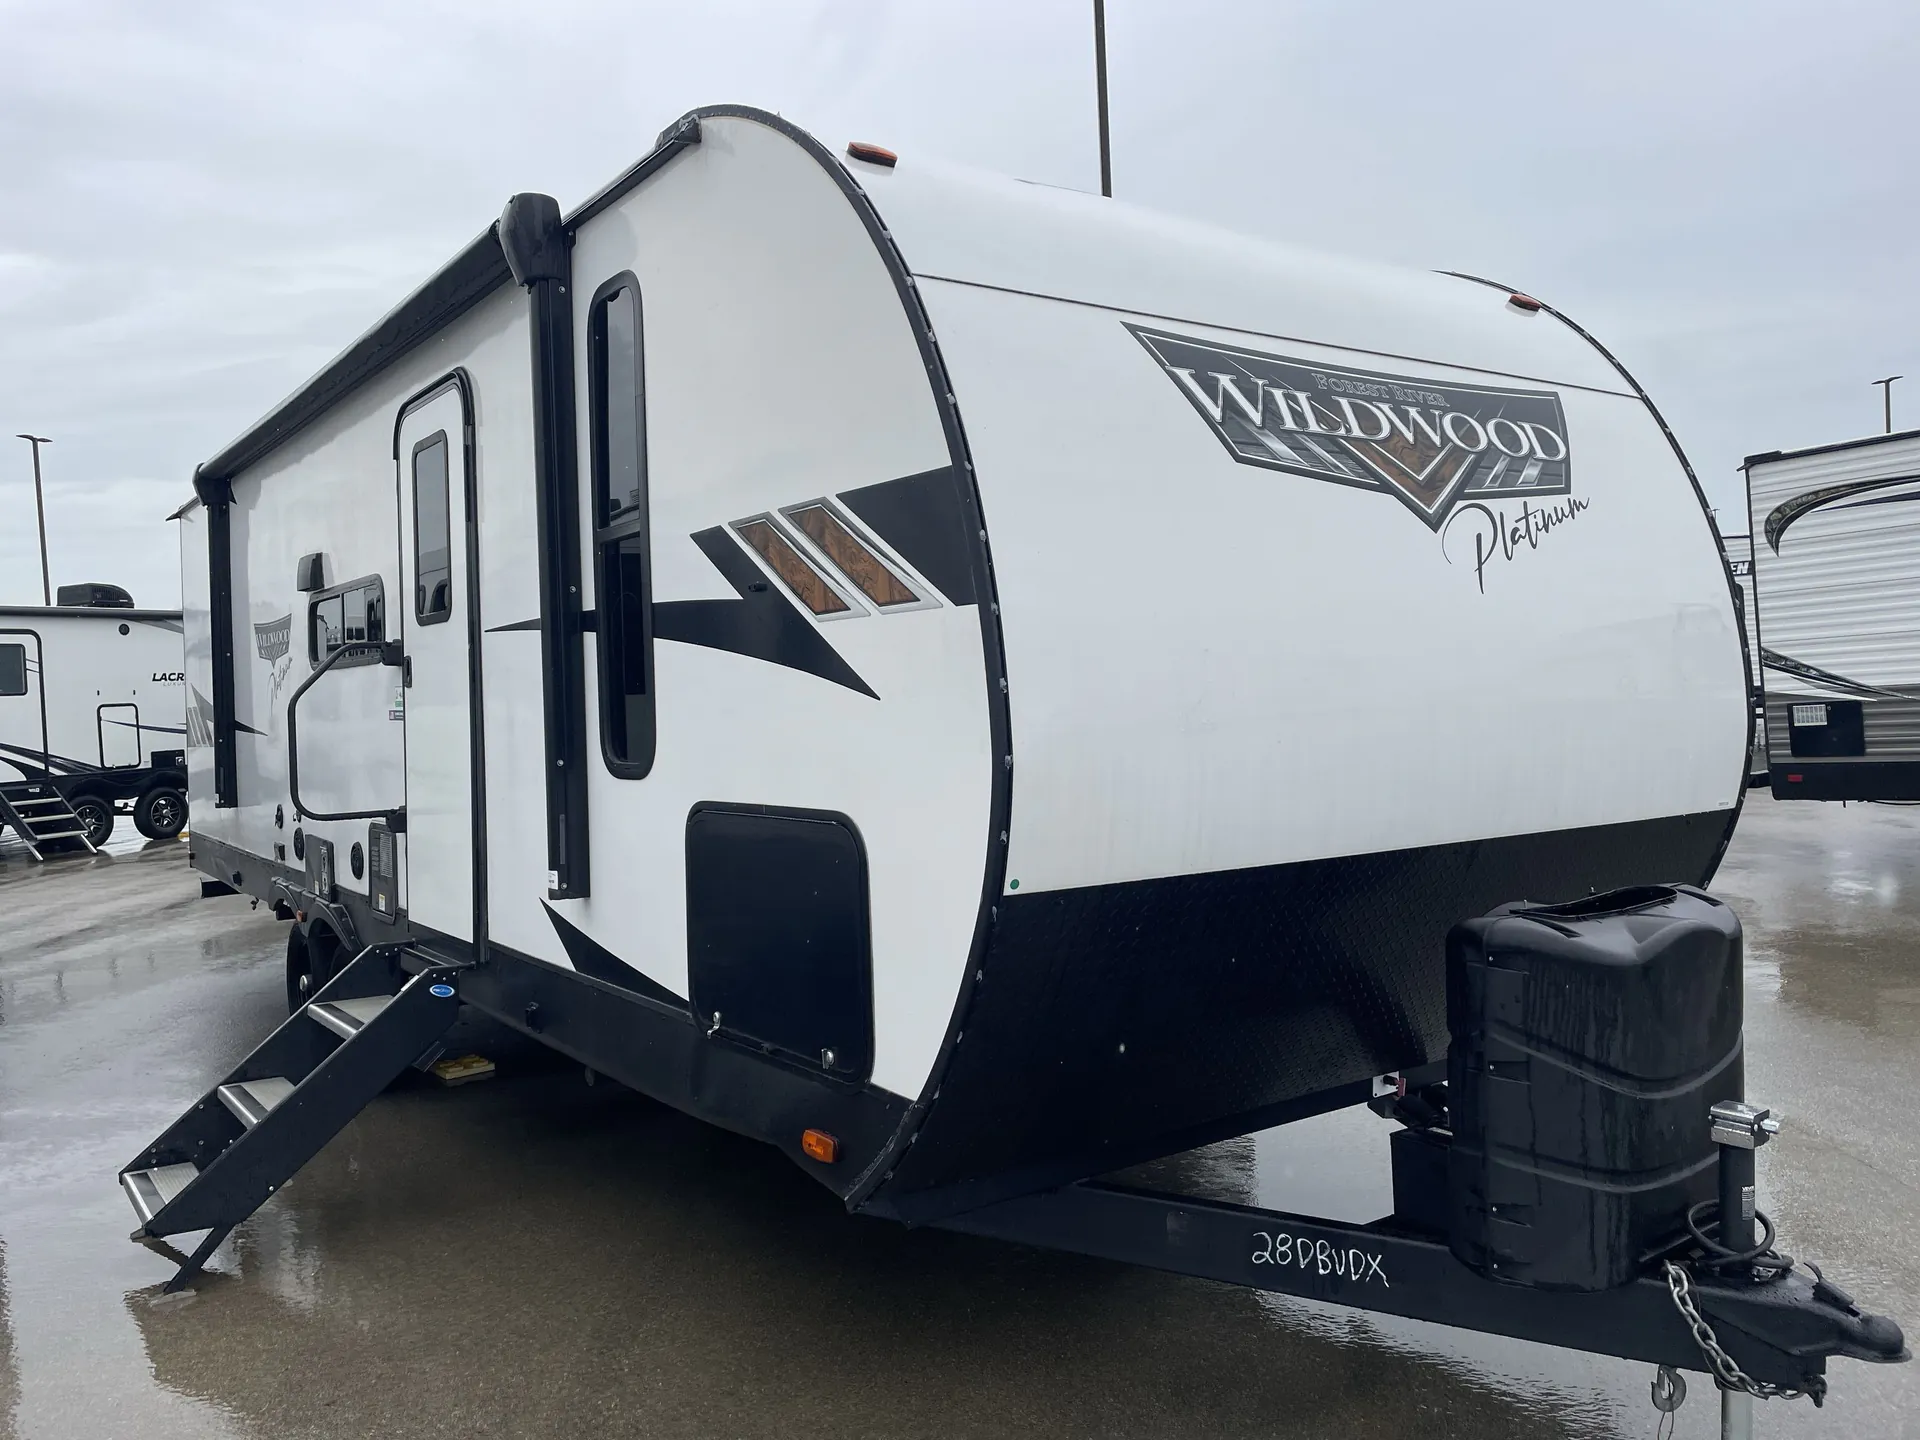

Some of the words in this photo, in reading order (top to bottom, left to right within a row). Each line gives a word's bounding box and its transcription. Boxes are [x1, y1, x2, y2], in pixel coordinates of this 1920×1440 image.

[1311, 373, 1390, 398] FOREST
[1388, 384, 1450, 407] RIVER
[1165, 365, 1567, 462] WILDWOOD
[1442, 497, 1590, 594] Platinum
[256, 629, 290, 648] WILDWOOD
[152, 672, 185, 682] LACR
